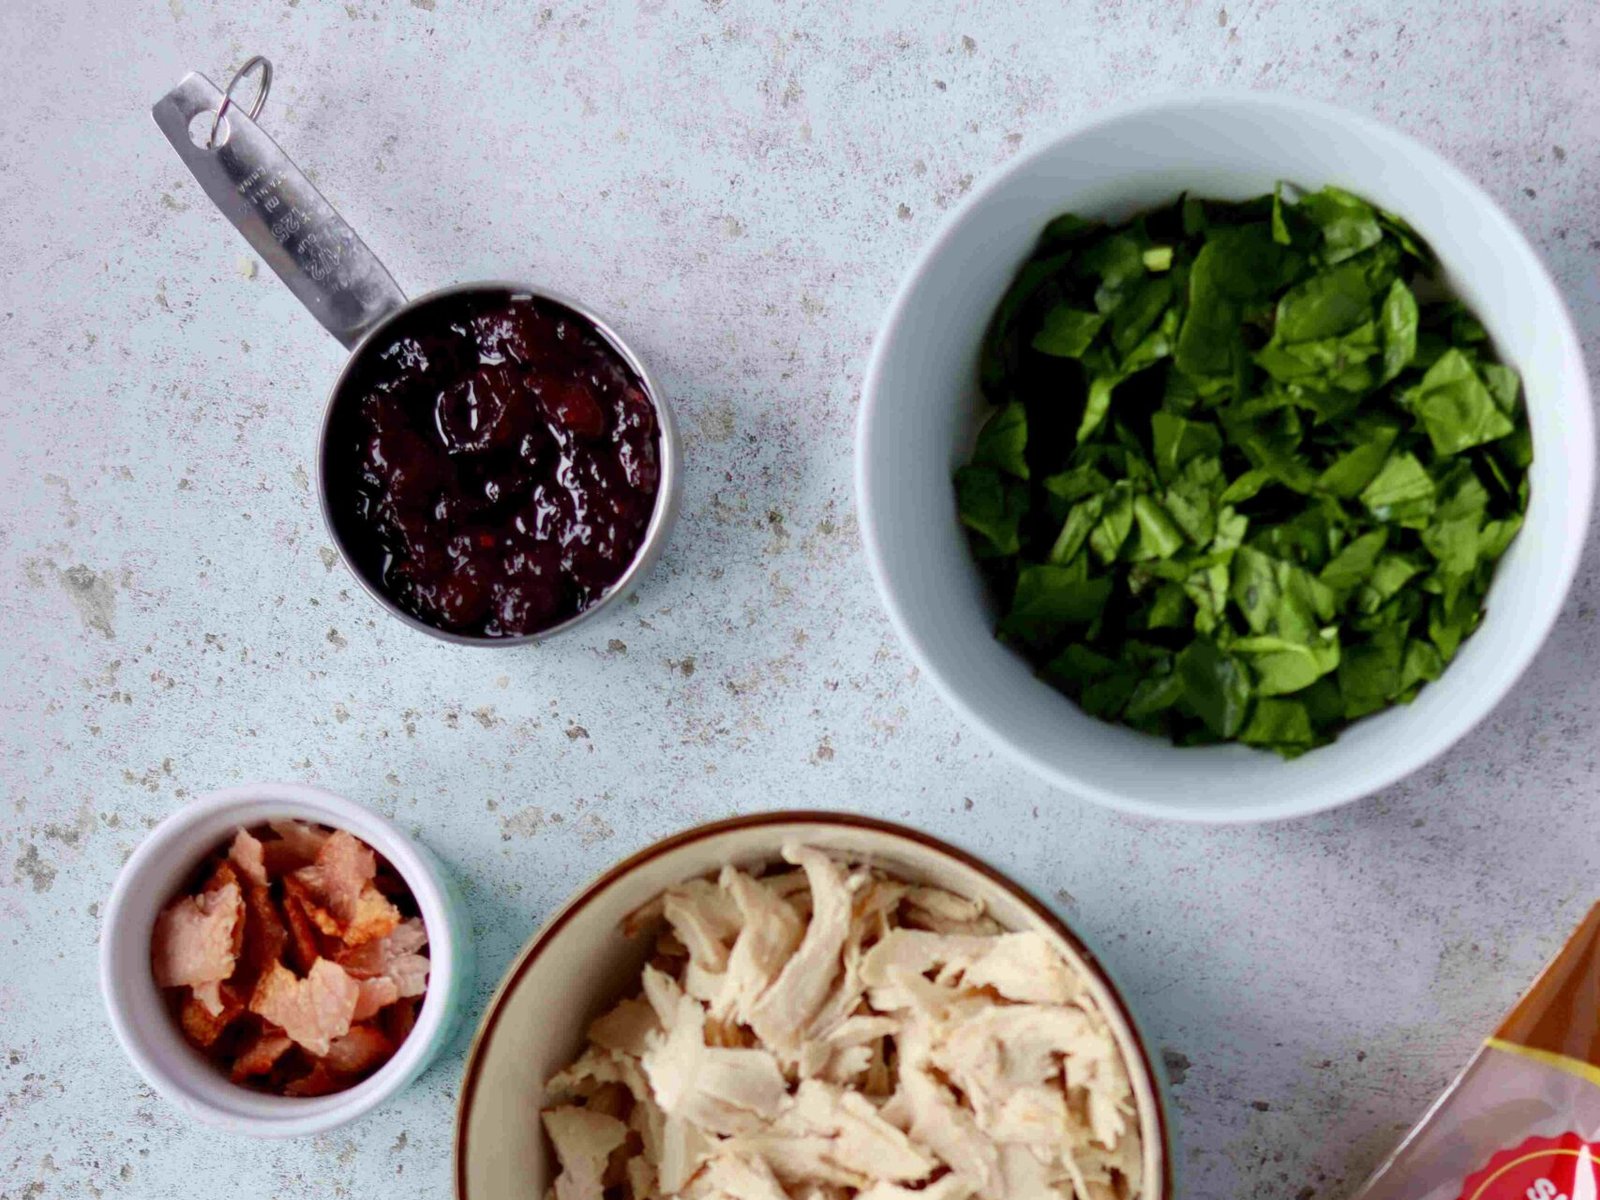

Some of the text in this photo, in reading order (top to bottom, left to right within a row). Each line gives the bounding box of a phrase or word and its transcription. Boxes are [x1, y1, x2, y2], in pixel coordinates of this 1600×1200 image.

[264, 195, 280, 213] ml
[271, 206, 311, 242] 125
[296, 232, 317, 253] CUP
